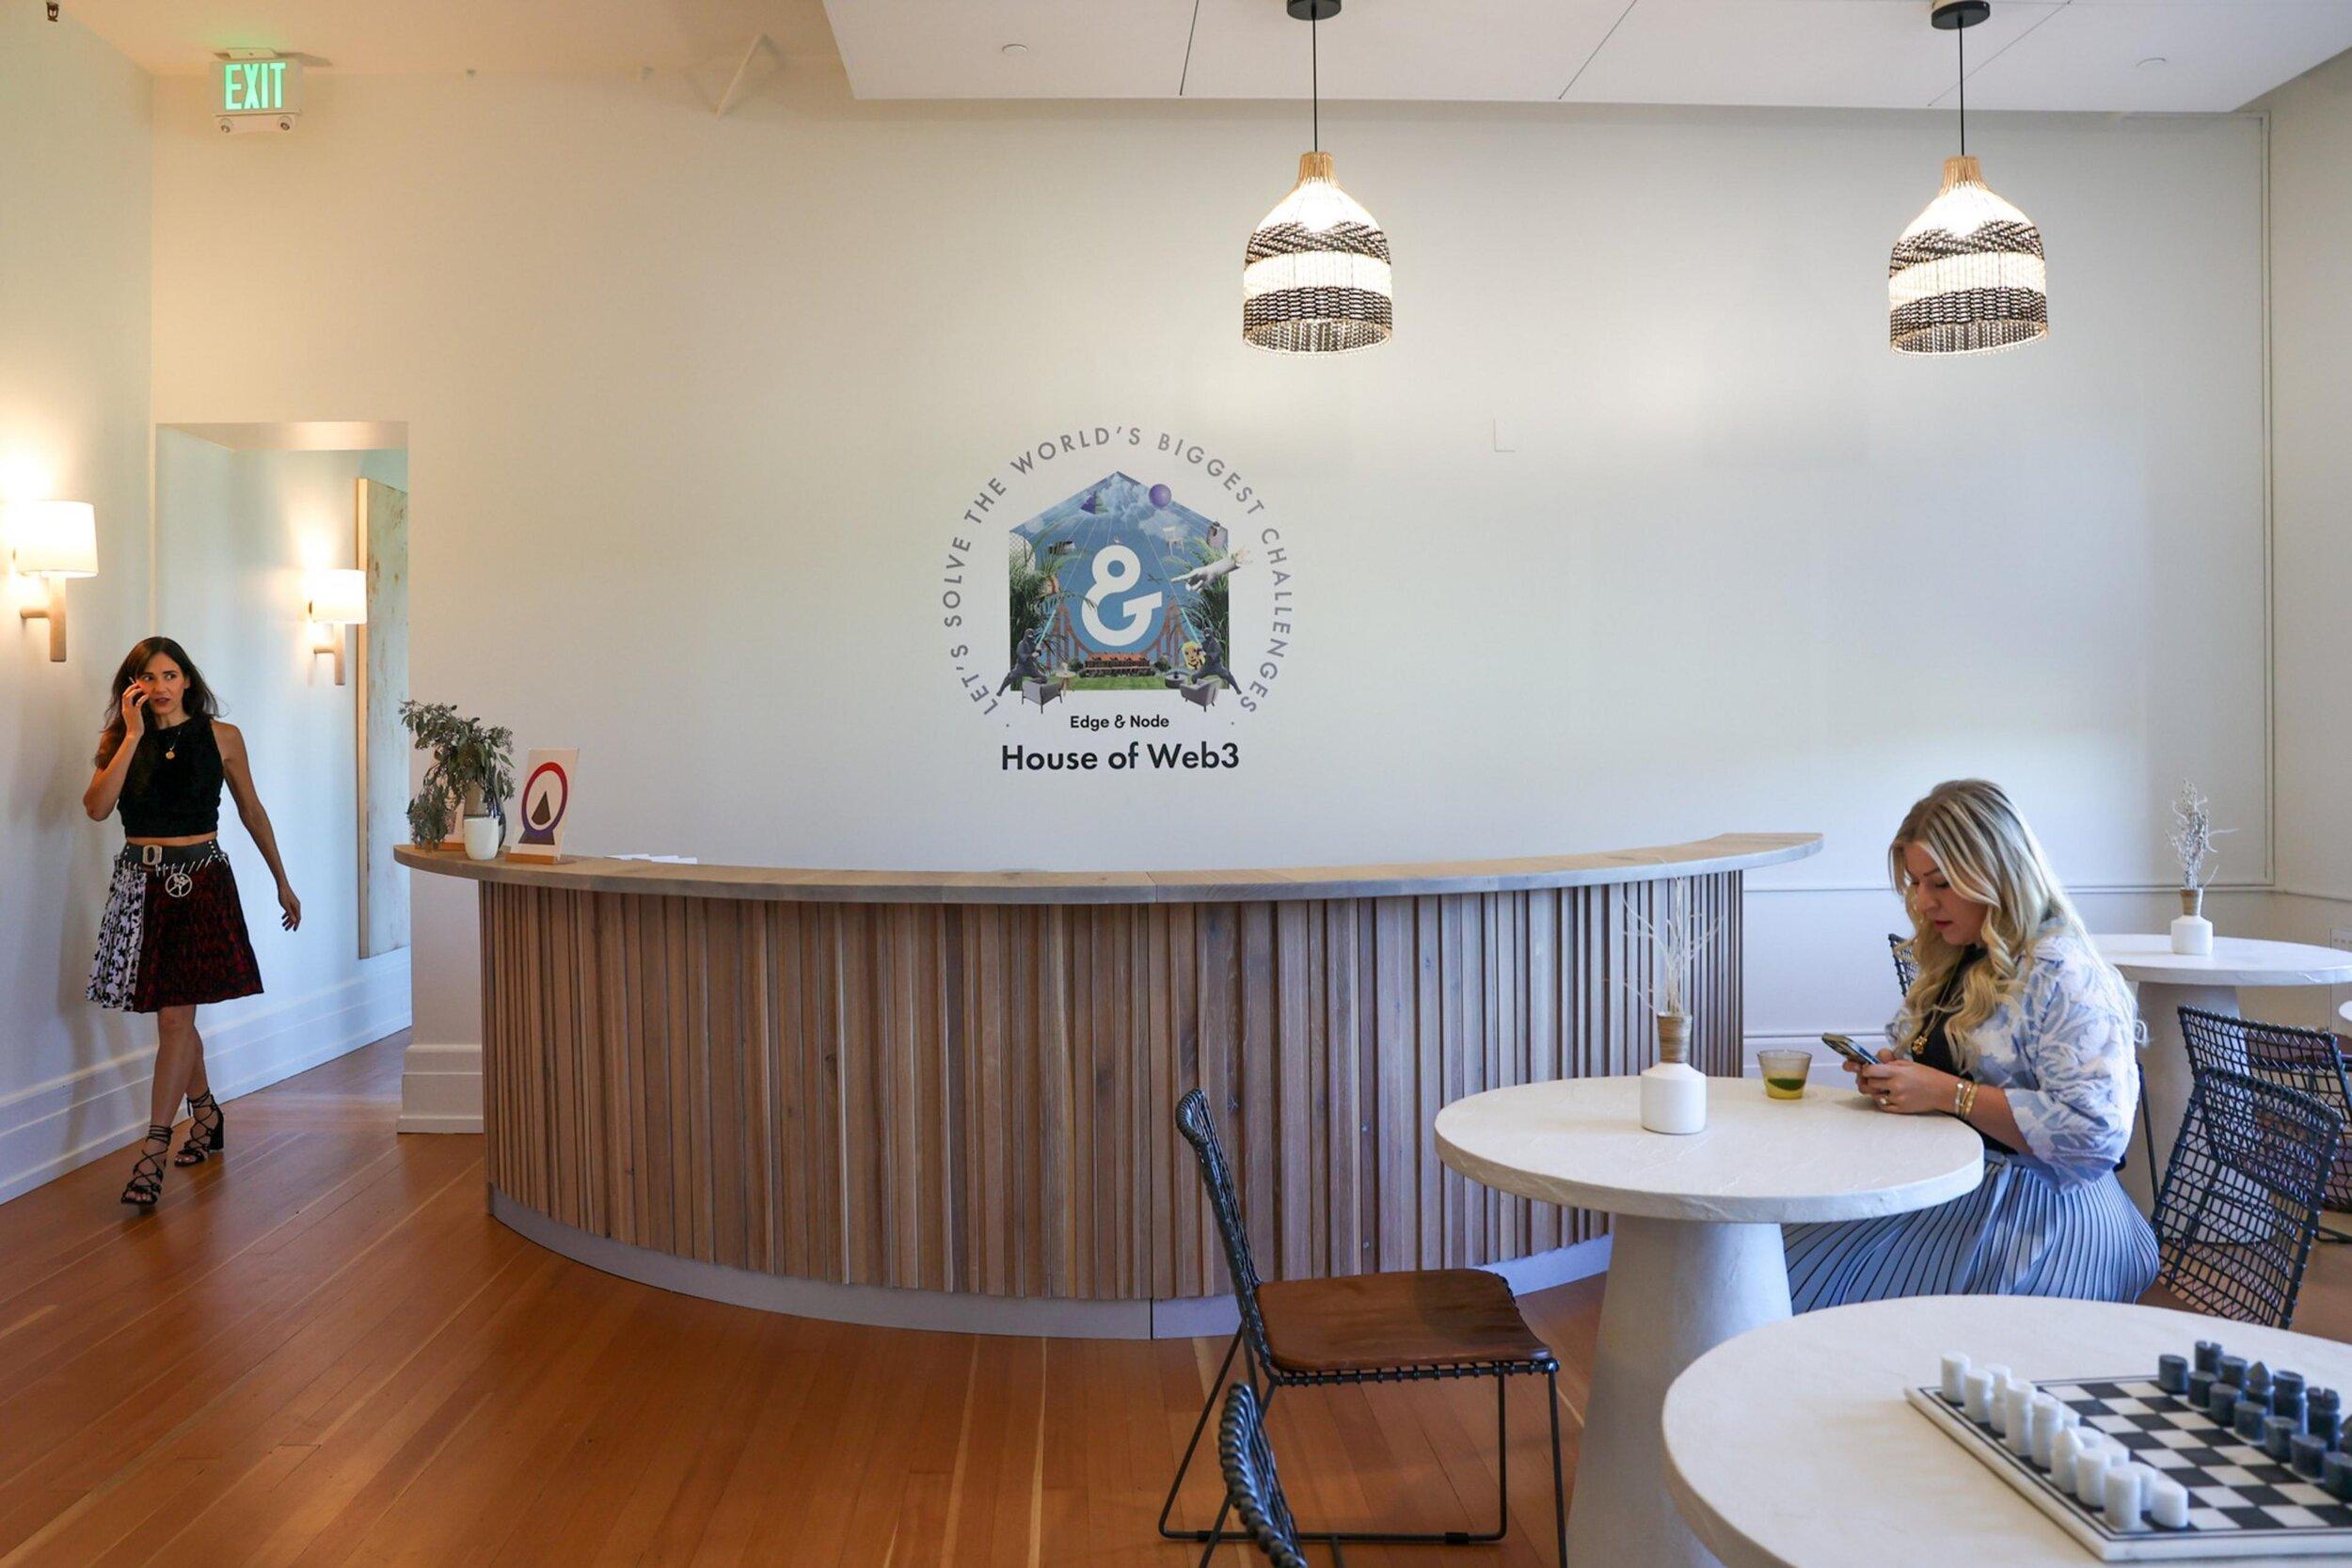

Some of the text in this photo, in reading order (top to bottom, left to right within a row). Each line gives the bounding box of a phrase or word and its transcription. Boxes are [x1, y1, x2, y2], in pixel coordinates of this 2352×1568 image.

[225, 62, 287, 110] EXIT
[943, 426, 1293, 715] LET'S SOLVE THE WORLD'S BIGGEST CHALLENGES
[1071, 715, 1109, 732] Edge
[1130, 715, 1169, 729] Node
[1002, 741, 1240, 770] House of Web3
